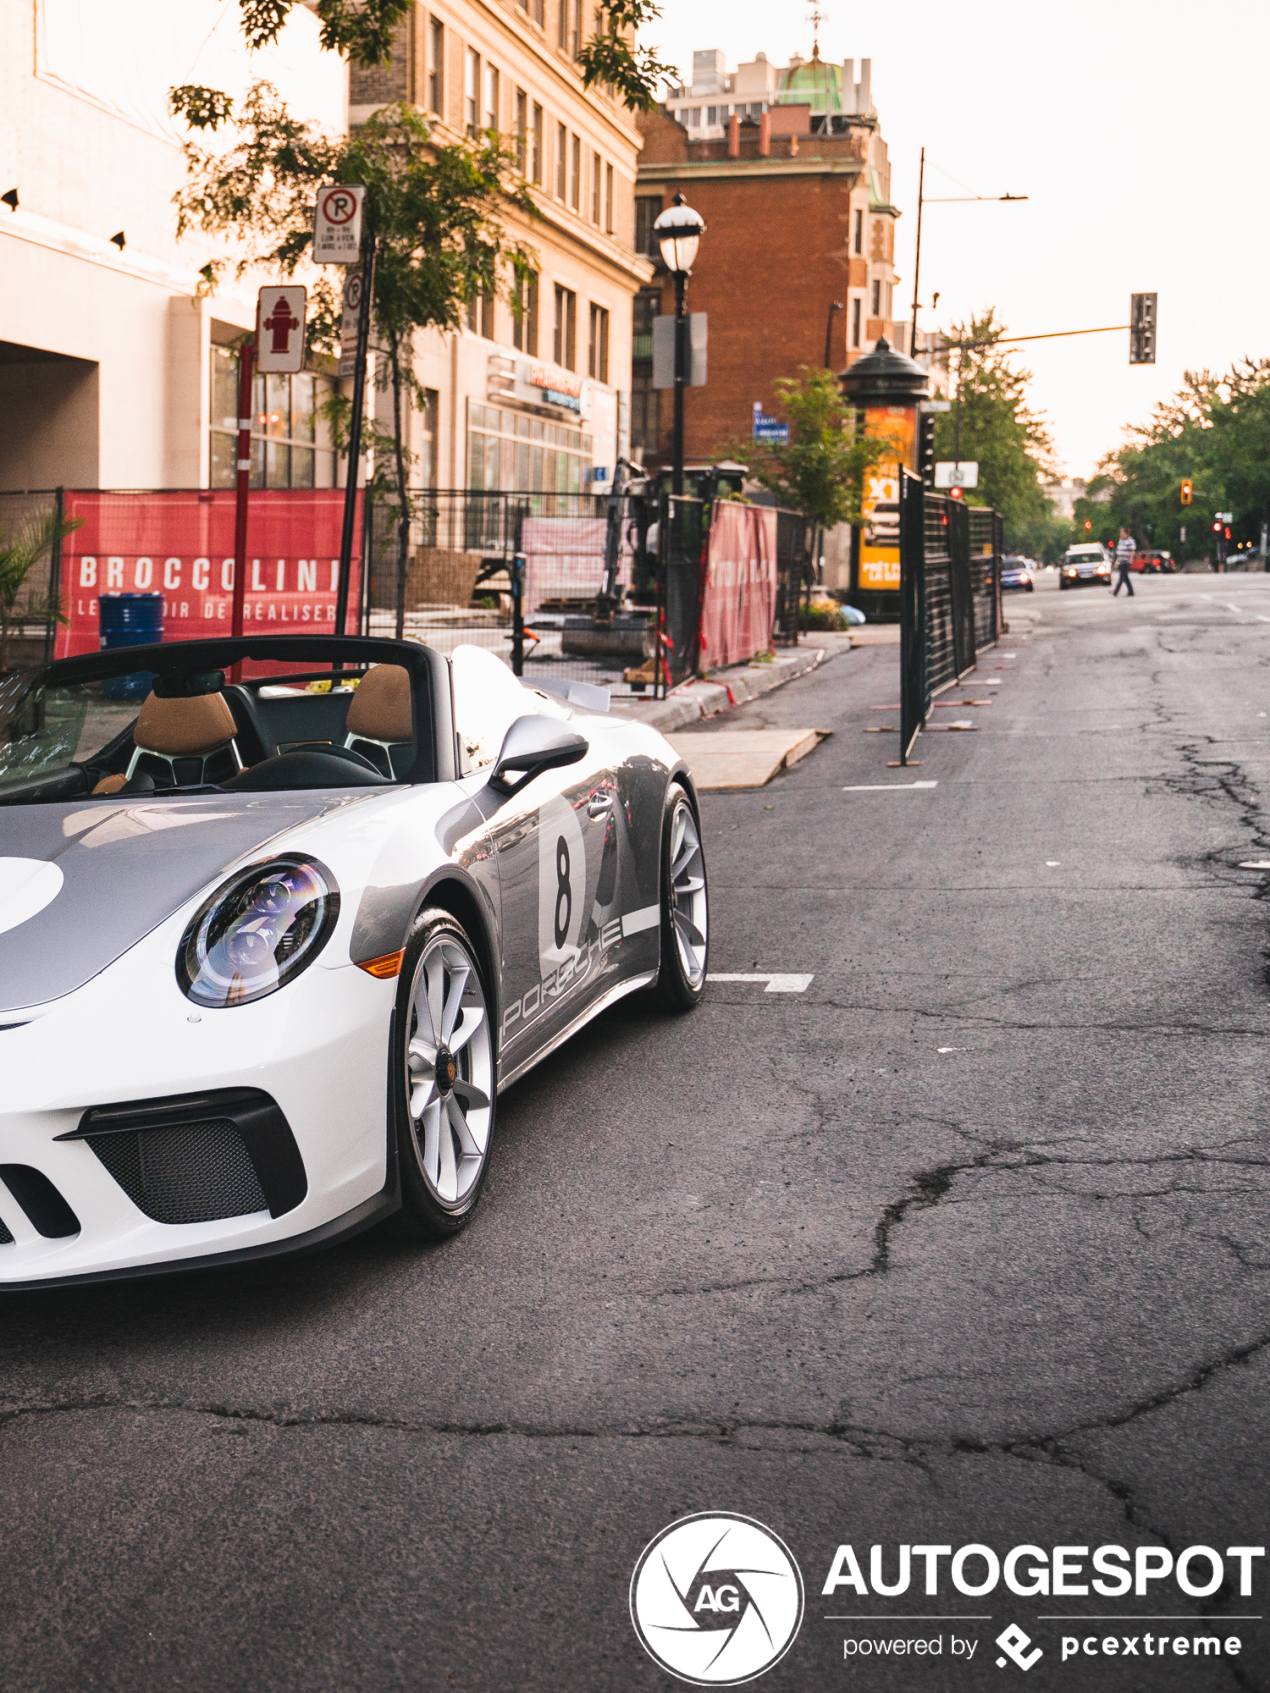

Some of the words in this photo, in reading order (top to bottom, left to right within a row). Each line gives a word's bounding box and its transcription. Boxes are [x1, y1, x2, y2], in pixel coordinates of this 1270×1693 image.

[80, 556, 339, 592] BROCCOLINI
[204, 602, 225, 619] DE
[243, 602, 336, 621] RÉALISER
[554, 835, 572, 949] 8
